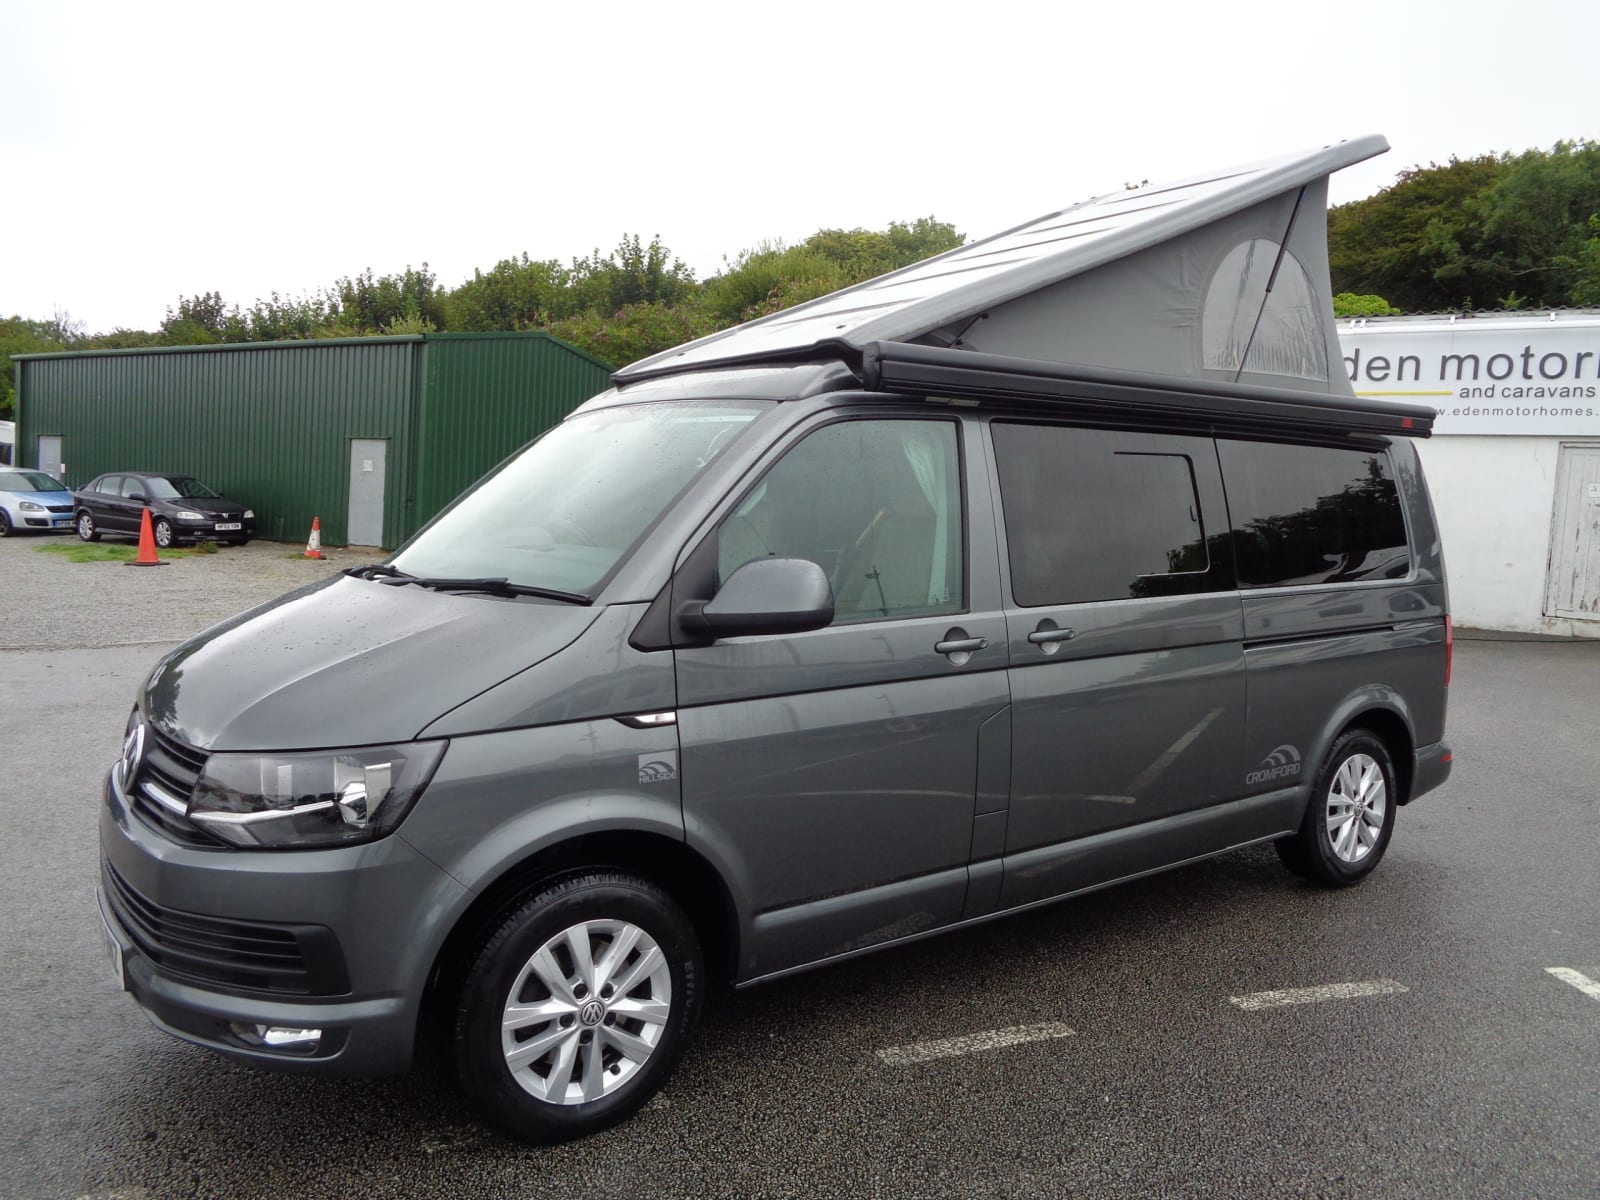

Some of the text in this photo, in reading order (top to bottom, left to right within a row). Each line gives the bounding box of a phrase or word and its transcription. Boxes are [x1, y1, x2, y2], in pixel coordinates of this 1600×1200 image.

[1343, 345, 1600, 382] den motor
[1459, 384, 1597, 399] and caravans
[1434, 406, 1600, 417] w.edenmotorhomes.
[638, 771, 678, 784] HILLSIDE
[1246, 762, 1301, 785] CROMFORD
